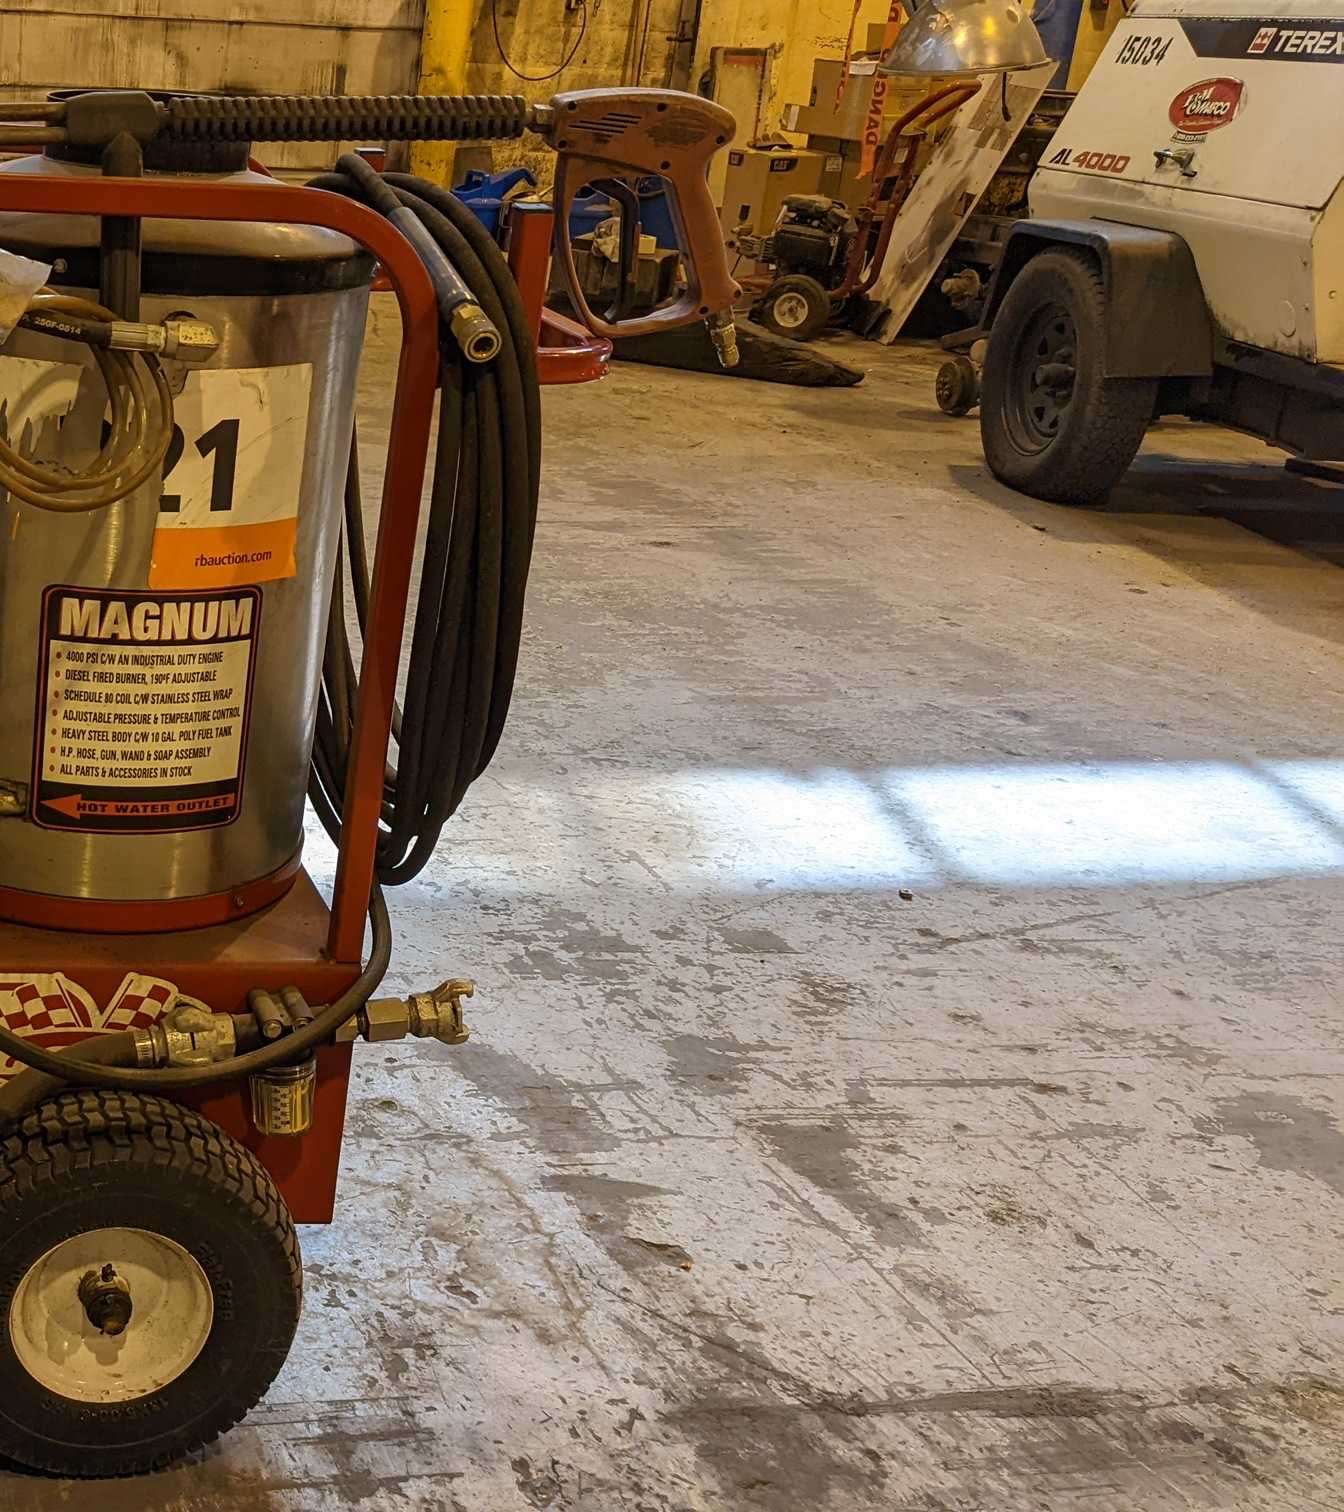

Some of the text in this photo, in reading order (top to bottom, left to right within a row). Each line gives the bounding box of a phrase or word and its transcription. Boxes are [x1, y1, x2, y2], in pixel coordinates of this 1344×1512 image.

[1115, 34, 1174, 66] 15034
[1274, 30, 1344, 55] TEREX
[194, 551, 272, 567] rbauction.com
[58, 597, 254, 641] MAGNUM
[66, 651, 224, 666] 4000 PSI C/W AN INDUSTRIAL DUTY ENGINE
[65, 669, 90, 682] DIESEL
[92, 671, 114, 683] FIRED
[115, 671, 148, 685] BURNER,
[171, 669, 217, 684] ADJUSTABLE
[64, 690, 103, 704] SCHEDULE
[115, 693, 132, 705] COIL
[133, 692, 149, 705] C/W
[151, 692, 190, 705] STAINLESS
[191, 690, 211, 703] STEEL
[212, 688, 233, 701] WRAP
[63, 707, 240, 725] ADJUSTABLE PRESSURE & TEMPERATURE CONTROL
[61, 725, 233, 743] HEAVY STEEL BODY C/W 10 GAL. POLY FUEL TANK
[60, 746, 212, 761] H.P. HOSE, GUN, WAND & SOAP ASSEMBLY
[60, 764, 193, 779] ALL PARTS & ACCESSORIES IN STOCK
[76, 797, 230, 814] HOT WATER OUTLET
